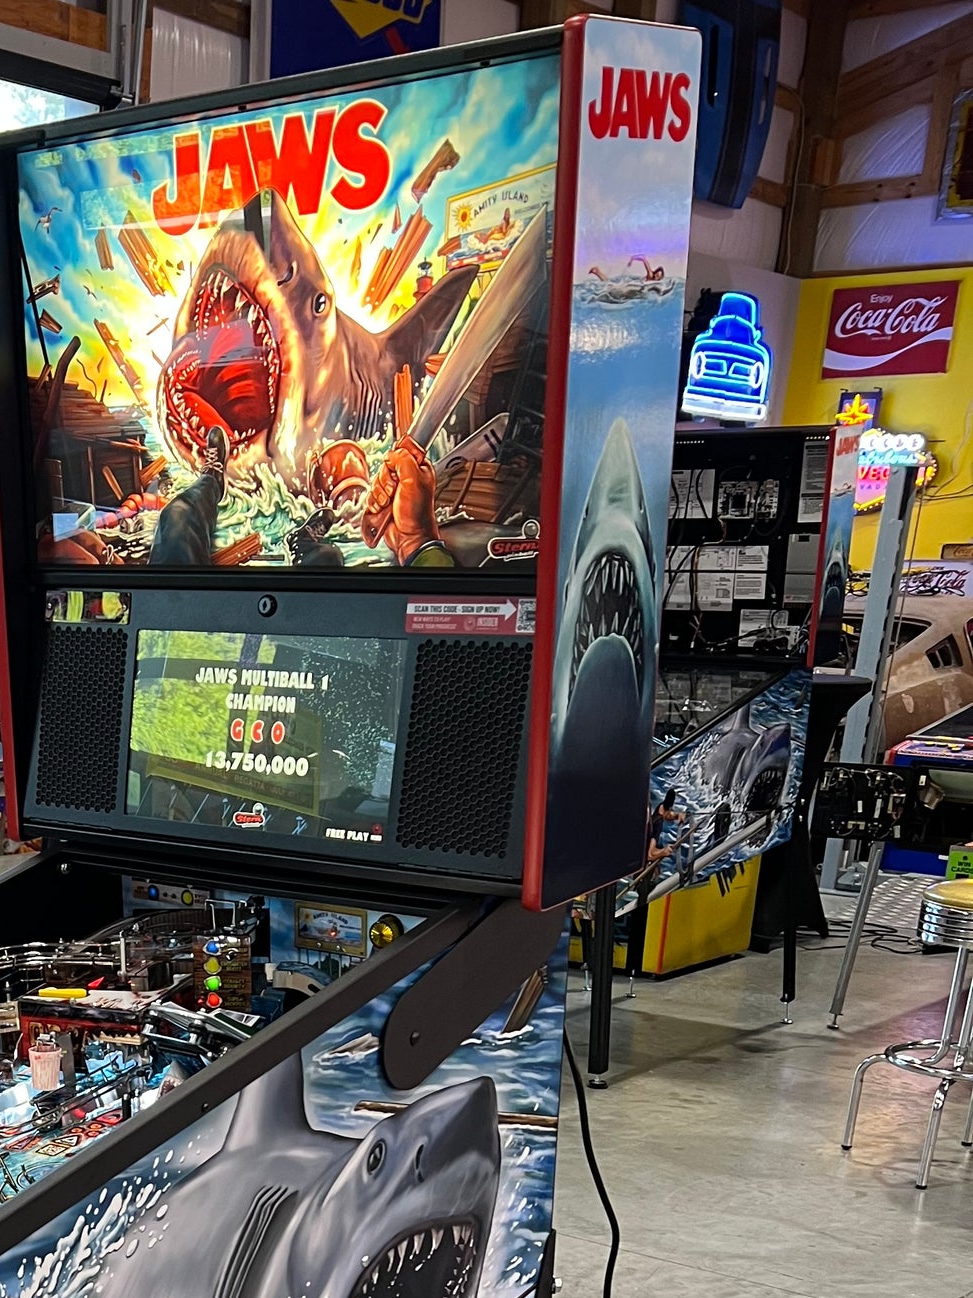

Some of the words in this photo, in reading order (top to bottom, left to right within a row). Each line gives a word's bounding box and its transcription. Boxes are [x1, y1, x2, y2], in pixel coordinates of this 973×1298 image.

[588, 66, 691, 142] JAWS
[151, 98, 393, 236] JAWS
[473, 195, 497, 219] AMITY
[870, 293, 893, 304] Enjoy
[835, 296, 948, 338] Coca-Cola
[493, 541, 539, 555] Stern
[414, 605, 428, 613] SCAN
[430, 605, 442, 613] THIS
[443, 605, 457, 613] CODE
[195, 667, 238, 685] JAWS
[240, 669, 315, 690] MULTIBALL
[321, 674, 329, 691] 1
[225, 693, 296, 714] CHAMPION
[230, 718, 245, 742] G
[251, 720, 264, 743] C
[204, 751, 309, 777] 13,750,000
[326, 828, 346, 840] FREE
[347, 830, 369, 842] PLAY
